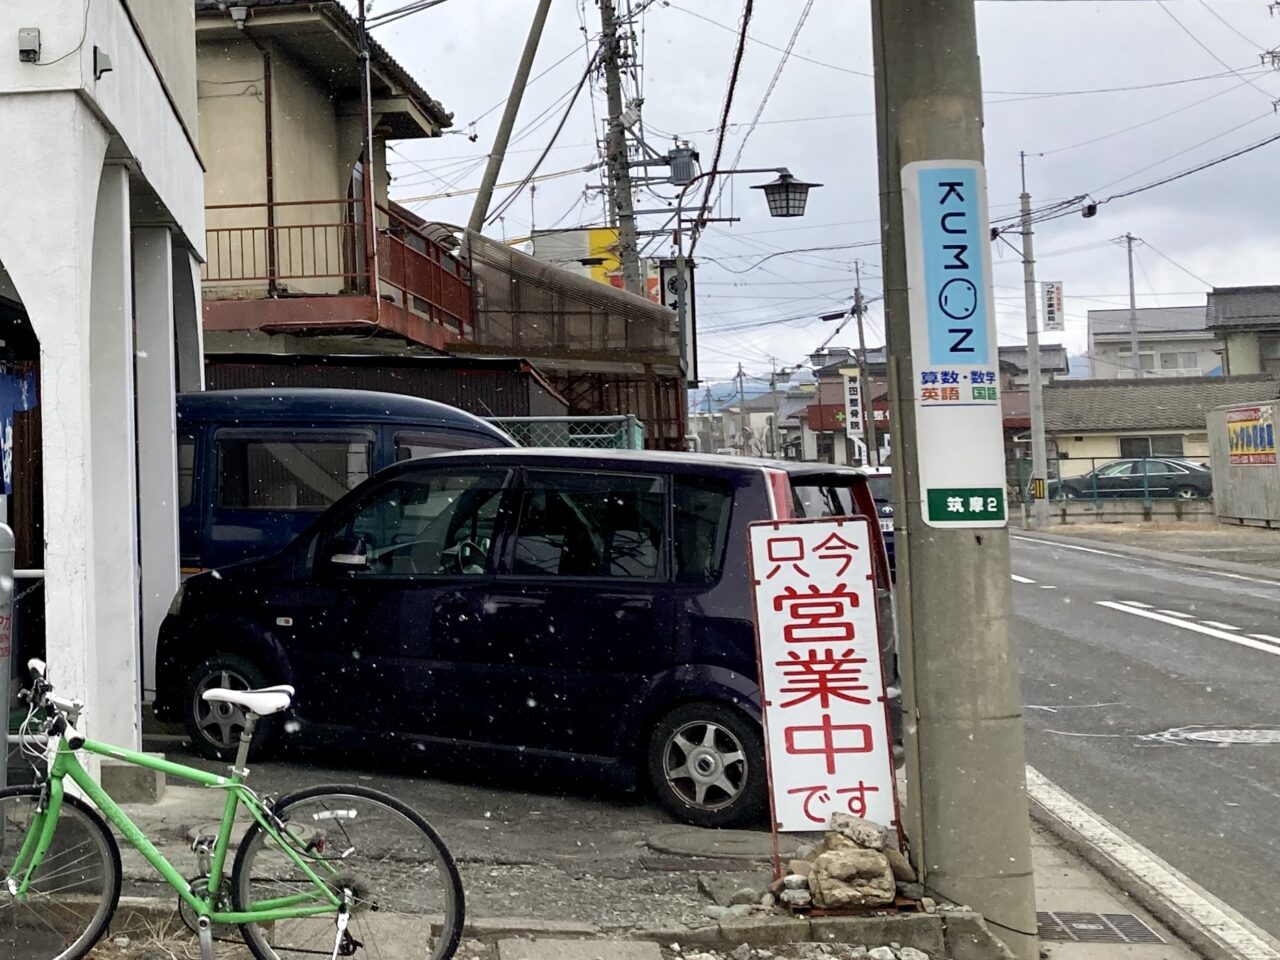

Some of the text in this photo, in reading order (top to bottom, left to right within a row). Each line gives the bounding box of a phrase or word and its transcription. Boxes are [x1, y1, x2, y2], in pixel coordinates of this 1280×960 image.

[938, 181, 978, 353] KUMON
[921, 370, 996, 385] 算数・数学
[921, 387, 960, 401] 英語
